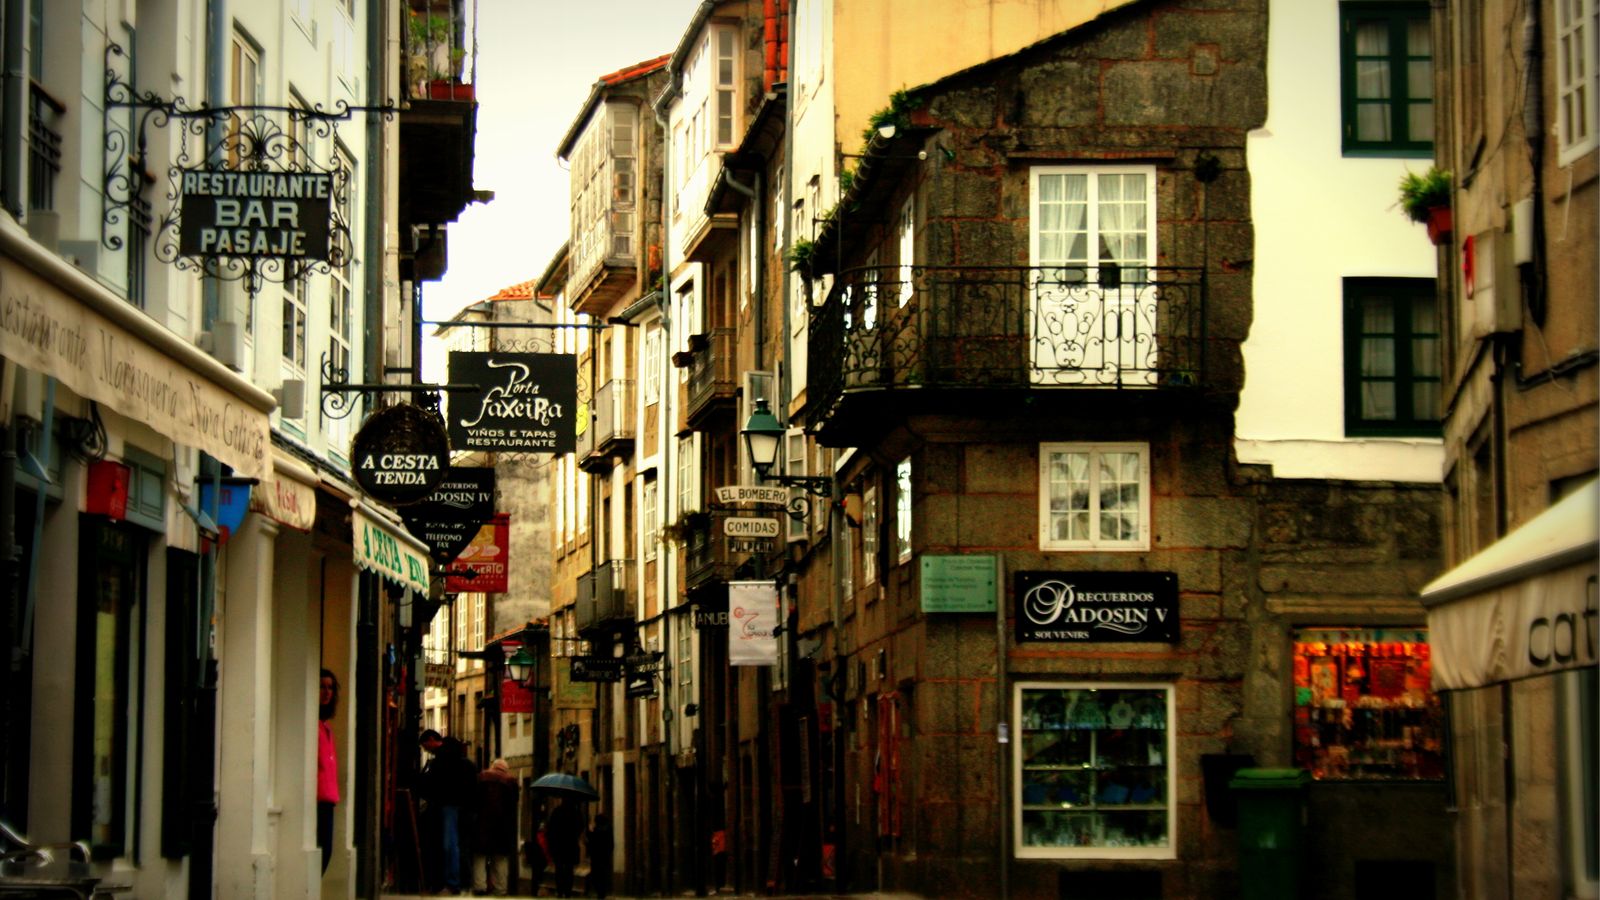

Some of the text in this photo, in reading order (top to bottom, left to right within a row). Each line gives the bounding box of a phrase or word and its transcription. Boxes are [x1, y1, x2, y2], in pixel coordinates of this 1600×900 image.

[184, 172, 330, 198] RESTAURANTE
[215, 199, 299, 228] BAR
[200, 229, 306, 255] PASAJE
[0, 295, 87, 371] estaurante
[487, 359, 540, 397] Porta
[468, 428, 505, 437] VIÑOS
[521, 430, 557, 438] TAPAS
[467, 438, 556, 447] RESTAURANTE
[361, 454, 439, 470] A CESTA
[374, 472, 426, 485] TENDA
[478, 492, 491, 502] IV
[721, 488, 786, 501] EL BOMBERO
[727, 521, 777, 534] COMIDAS
[364, 522, 371, 559] A
[425, 533, 462, 542] TELEFONO
[1077, 592, 1154, 603] RECUERDOS
[1155, 608, 1168, 623] V
[1035, 630, 1089, 639] SOUVENIRS
